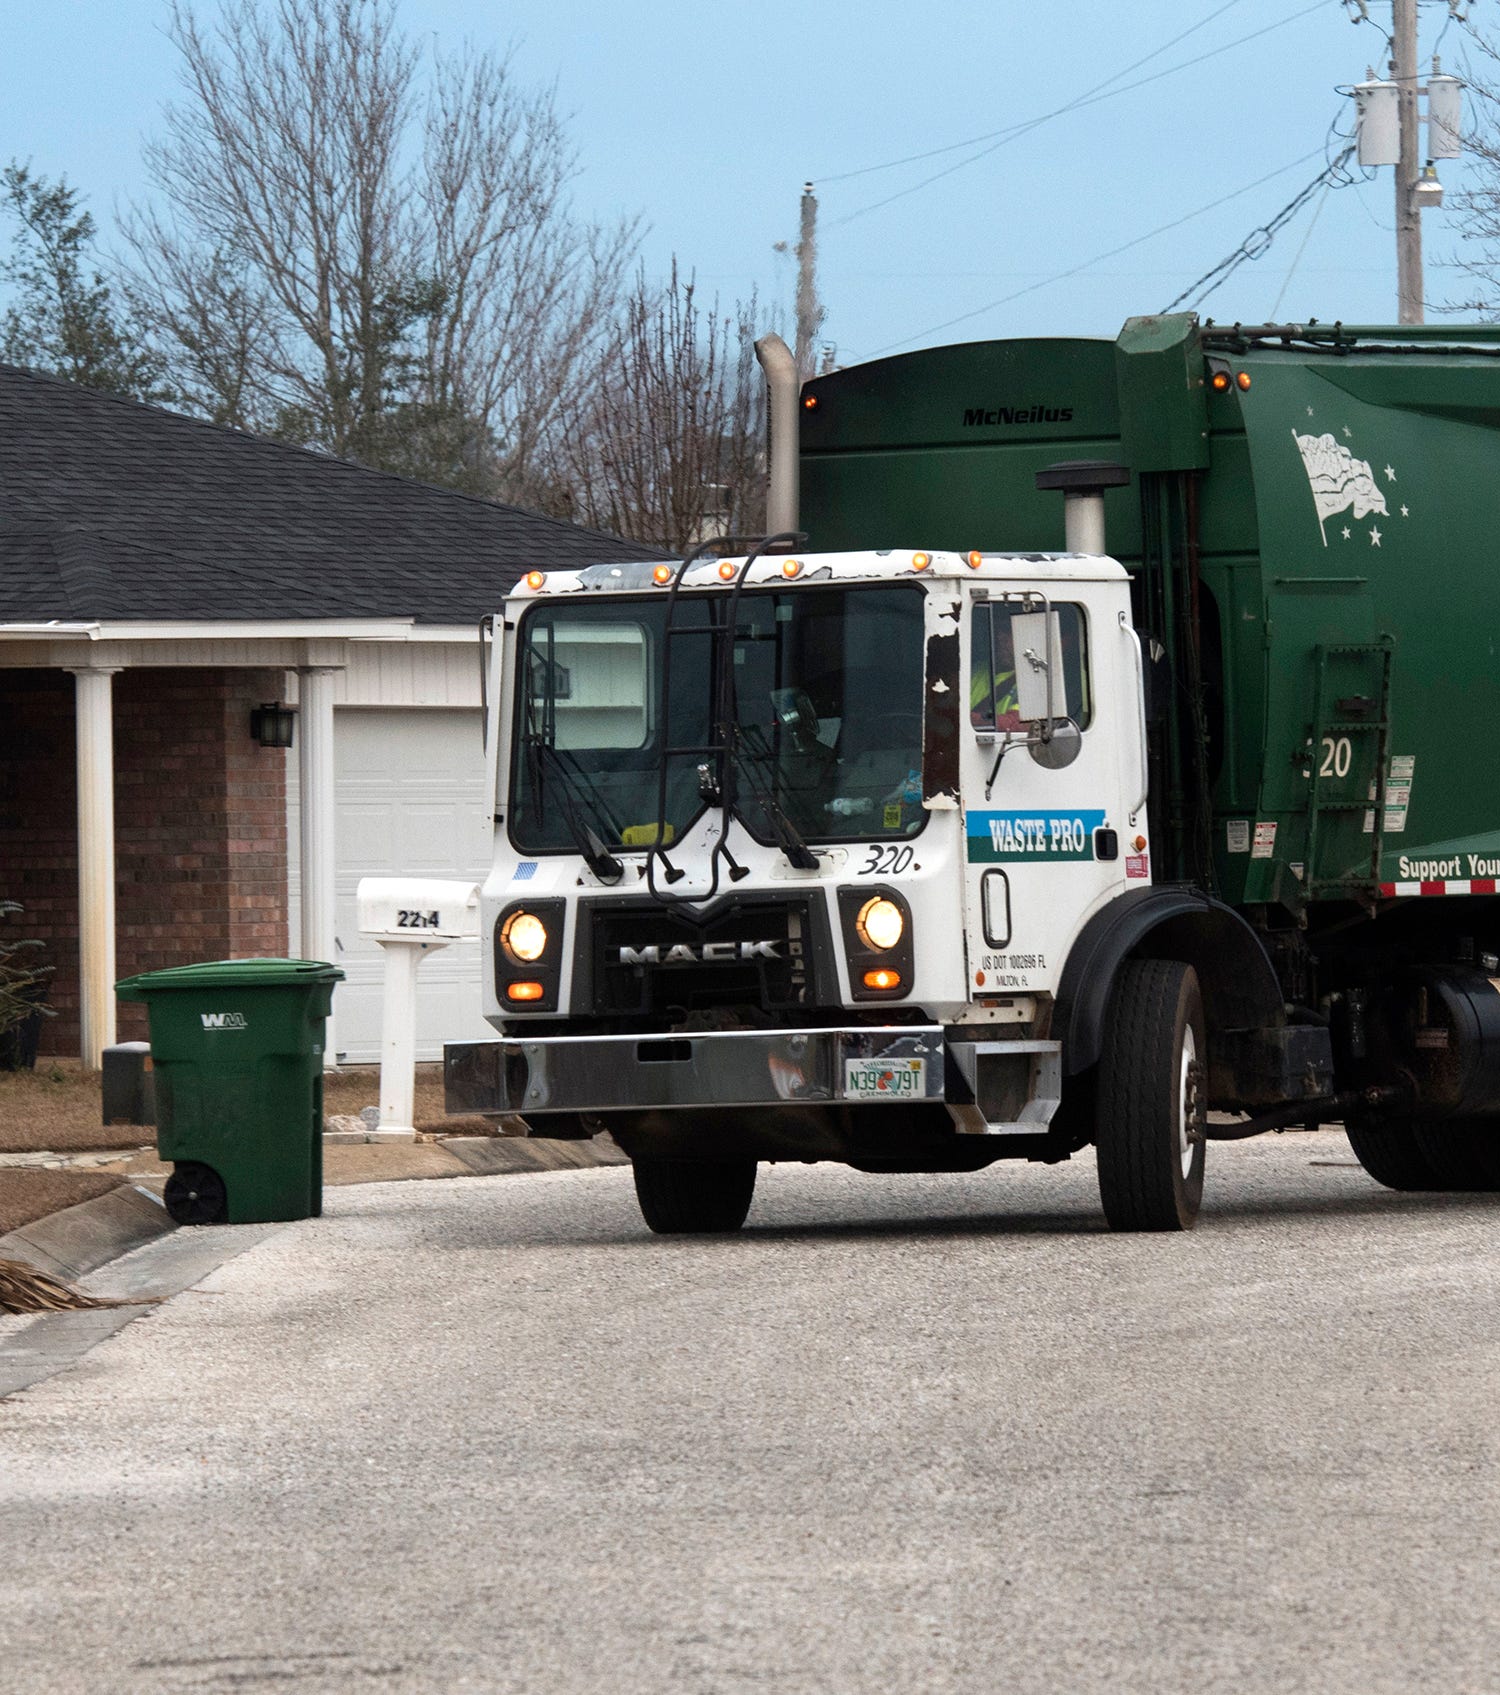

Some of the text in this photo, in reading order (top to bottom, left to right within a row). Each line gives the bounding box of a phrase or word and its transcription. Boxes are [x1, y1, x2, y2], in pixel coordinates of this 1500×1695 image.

[963, 406, 1074, 426] McNeilus
[989, 818, 1085, 853] WASTE PRO
[857, 844, 914, 875] 320
[1399, 855, 1461, 882] Support
[619, 940, 783, 964] MACK
[982, 955, 991, 970] US
[993, 955, 1007, 969] DOT
[1038, 954, 1047, 968] FL
[1021, 974, 1029, 986] FL
